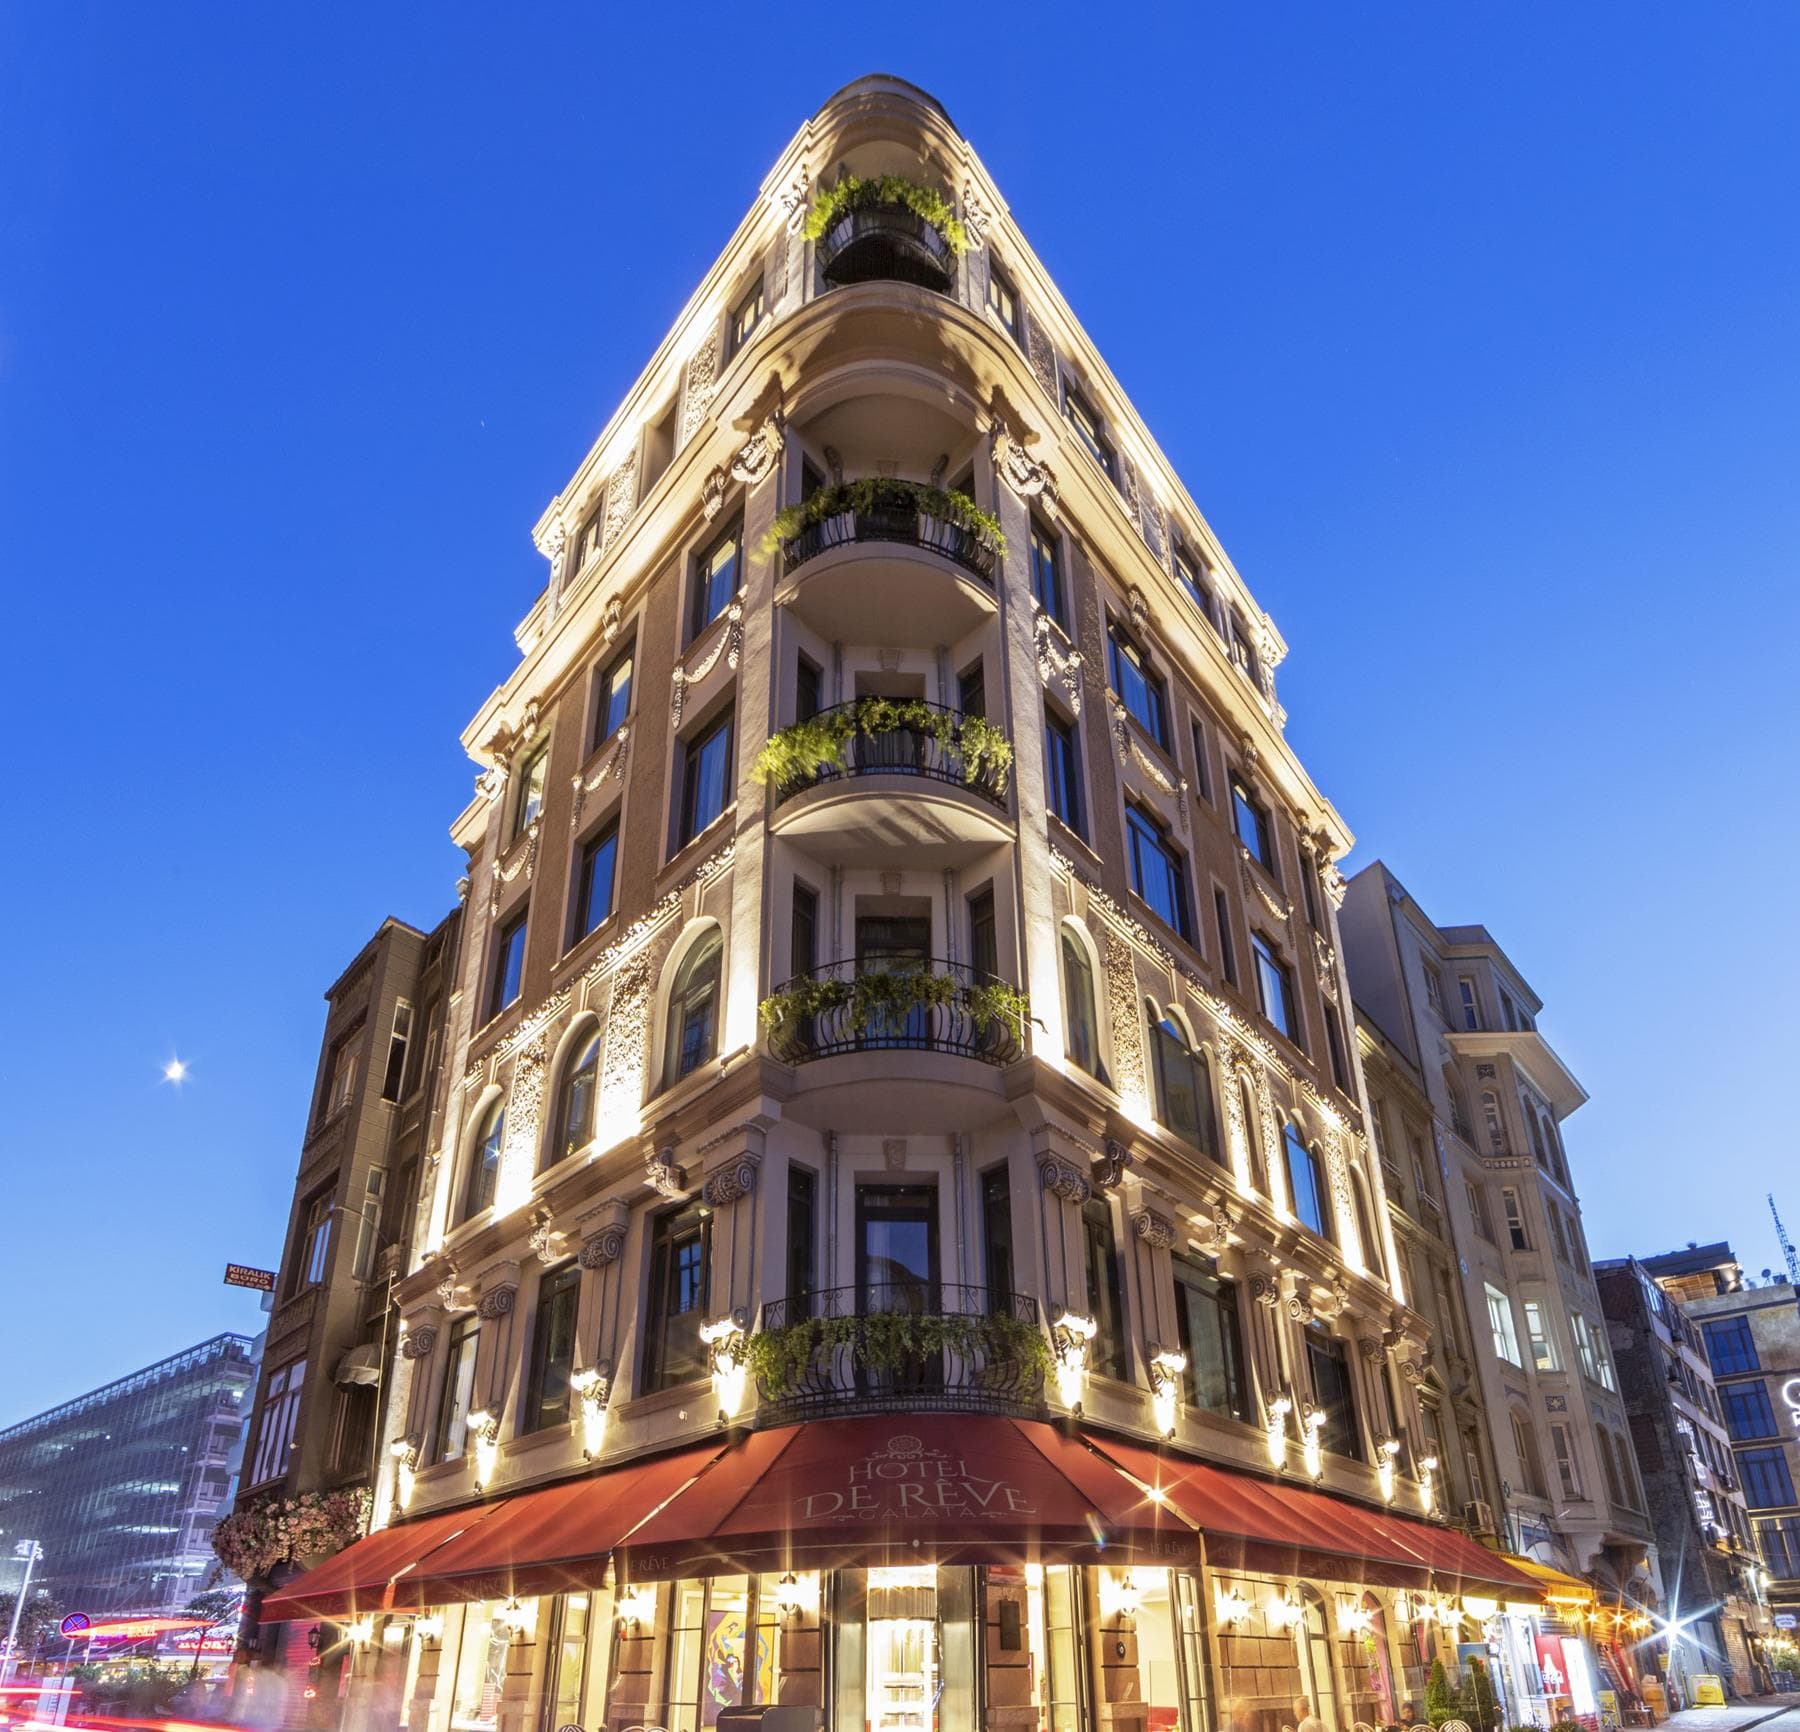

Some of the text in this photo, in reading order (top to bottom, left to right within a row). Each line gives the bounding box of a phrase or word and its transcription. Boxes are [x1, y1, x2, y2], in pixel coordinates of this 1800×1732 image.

[849, 1460, 992, 1484] HOTEL
[794, 1479, 1037, 1518] DE RÊVE
[859, 1507, 976, 1520] GALATA
